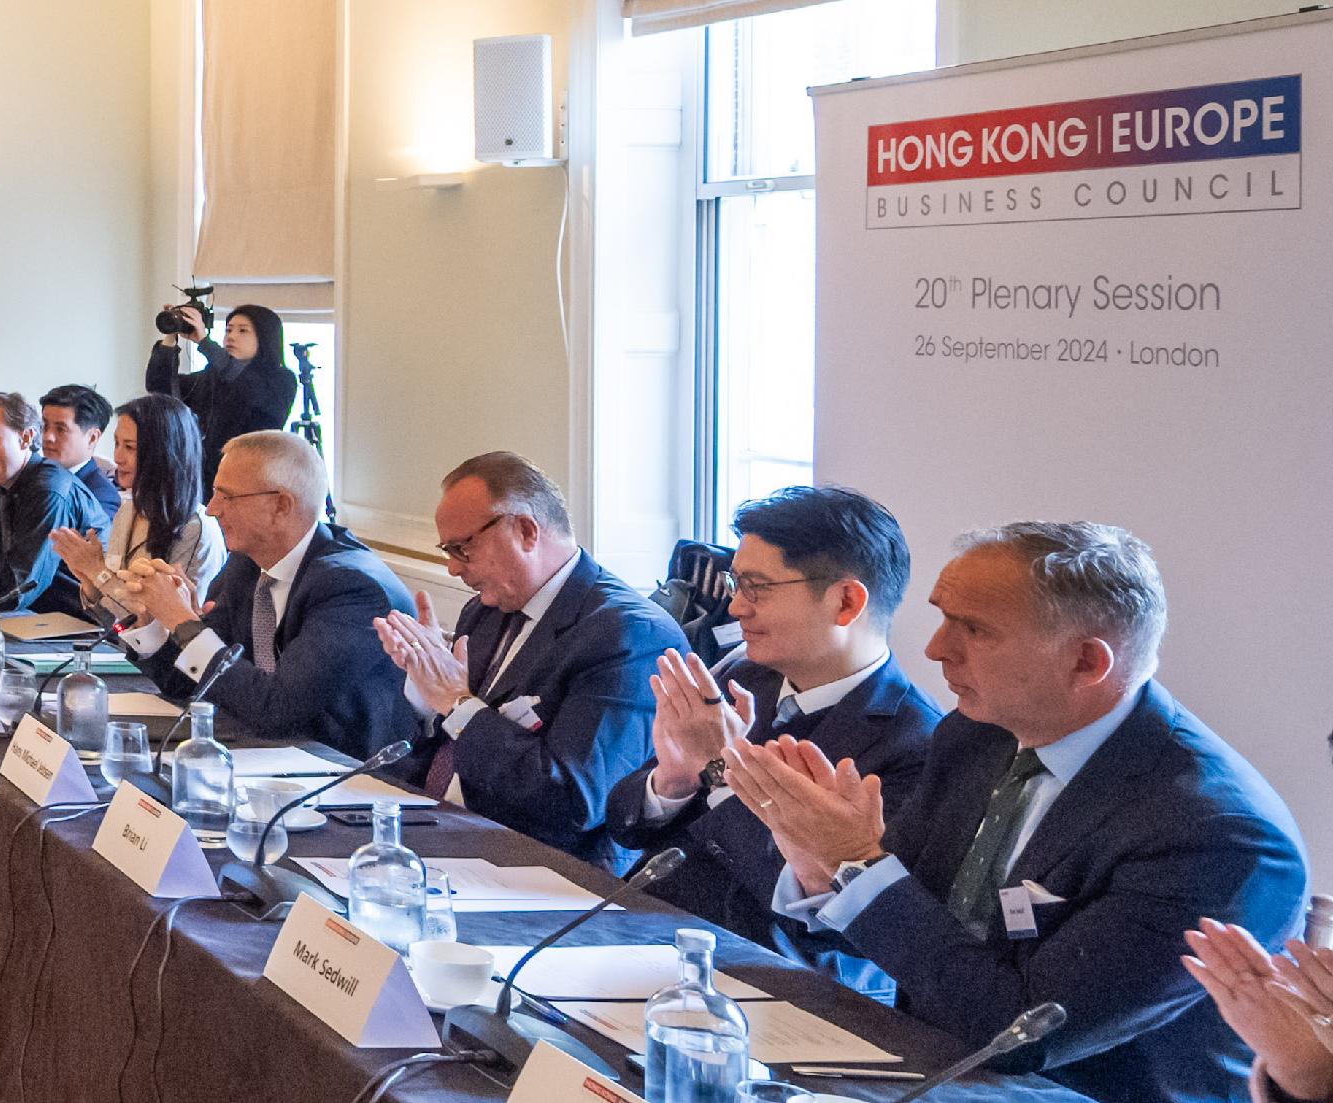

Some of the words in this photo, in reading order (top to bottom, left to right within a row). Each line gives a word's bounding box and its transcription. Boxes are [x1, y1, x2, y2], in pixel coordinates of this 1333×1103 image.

[876, 129, 973, 173] HONG
[981, 117, 1087, 164] KONG
[1112, 96, 1285, 153] EUROPE
[877, 186, 1042, 218] BUSINESS
[1074, 170, 1284, 207] COUNCIL
[914, 275, 962, 309] 20th
[972, 276, 1081, 317] Plenary
[1093, 275, 1221, 311] Session
[914, 335, 936, 356] 26
[942, 335, 1049, 364] September
[1057, 339, 1108, 363] 2024
[1130, 341, 1220, 367] London
[122, 824, 141, 847] Brian
[139, 836, 149, 850] Li
[293, 939, 319, 971] Mark
[318, 958, 359, 997] Sedwill
